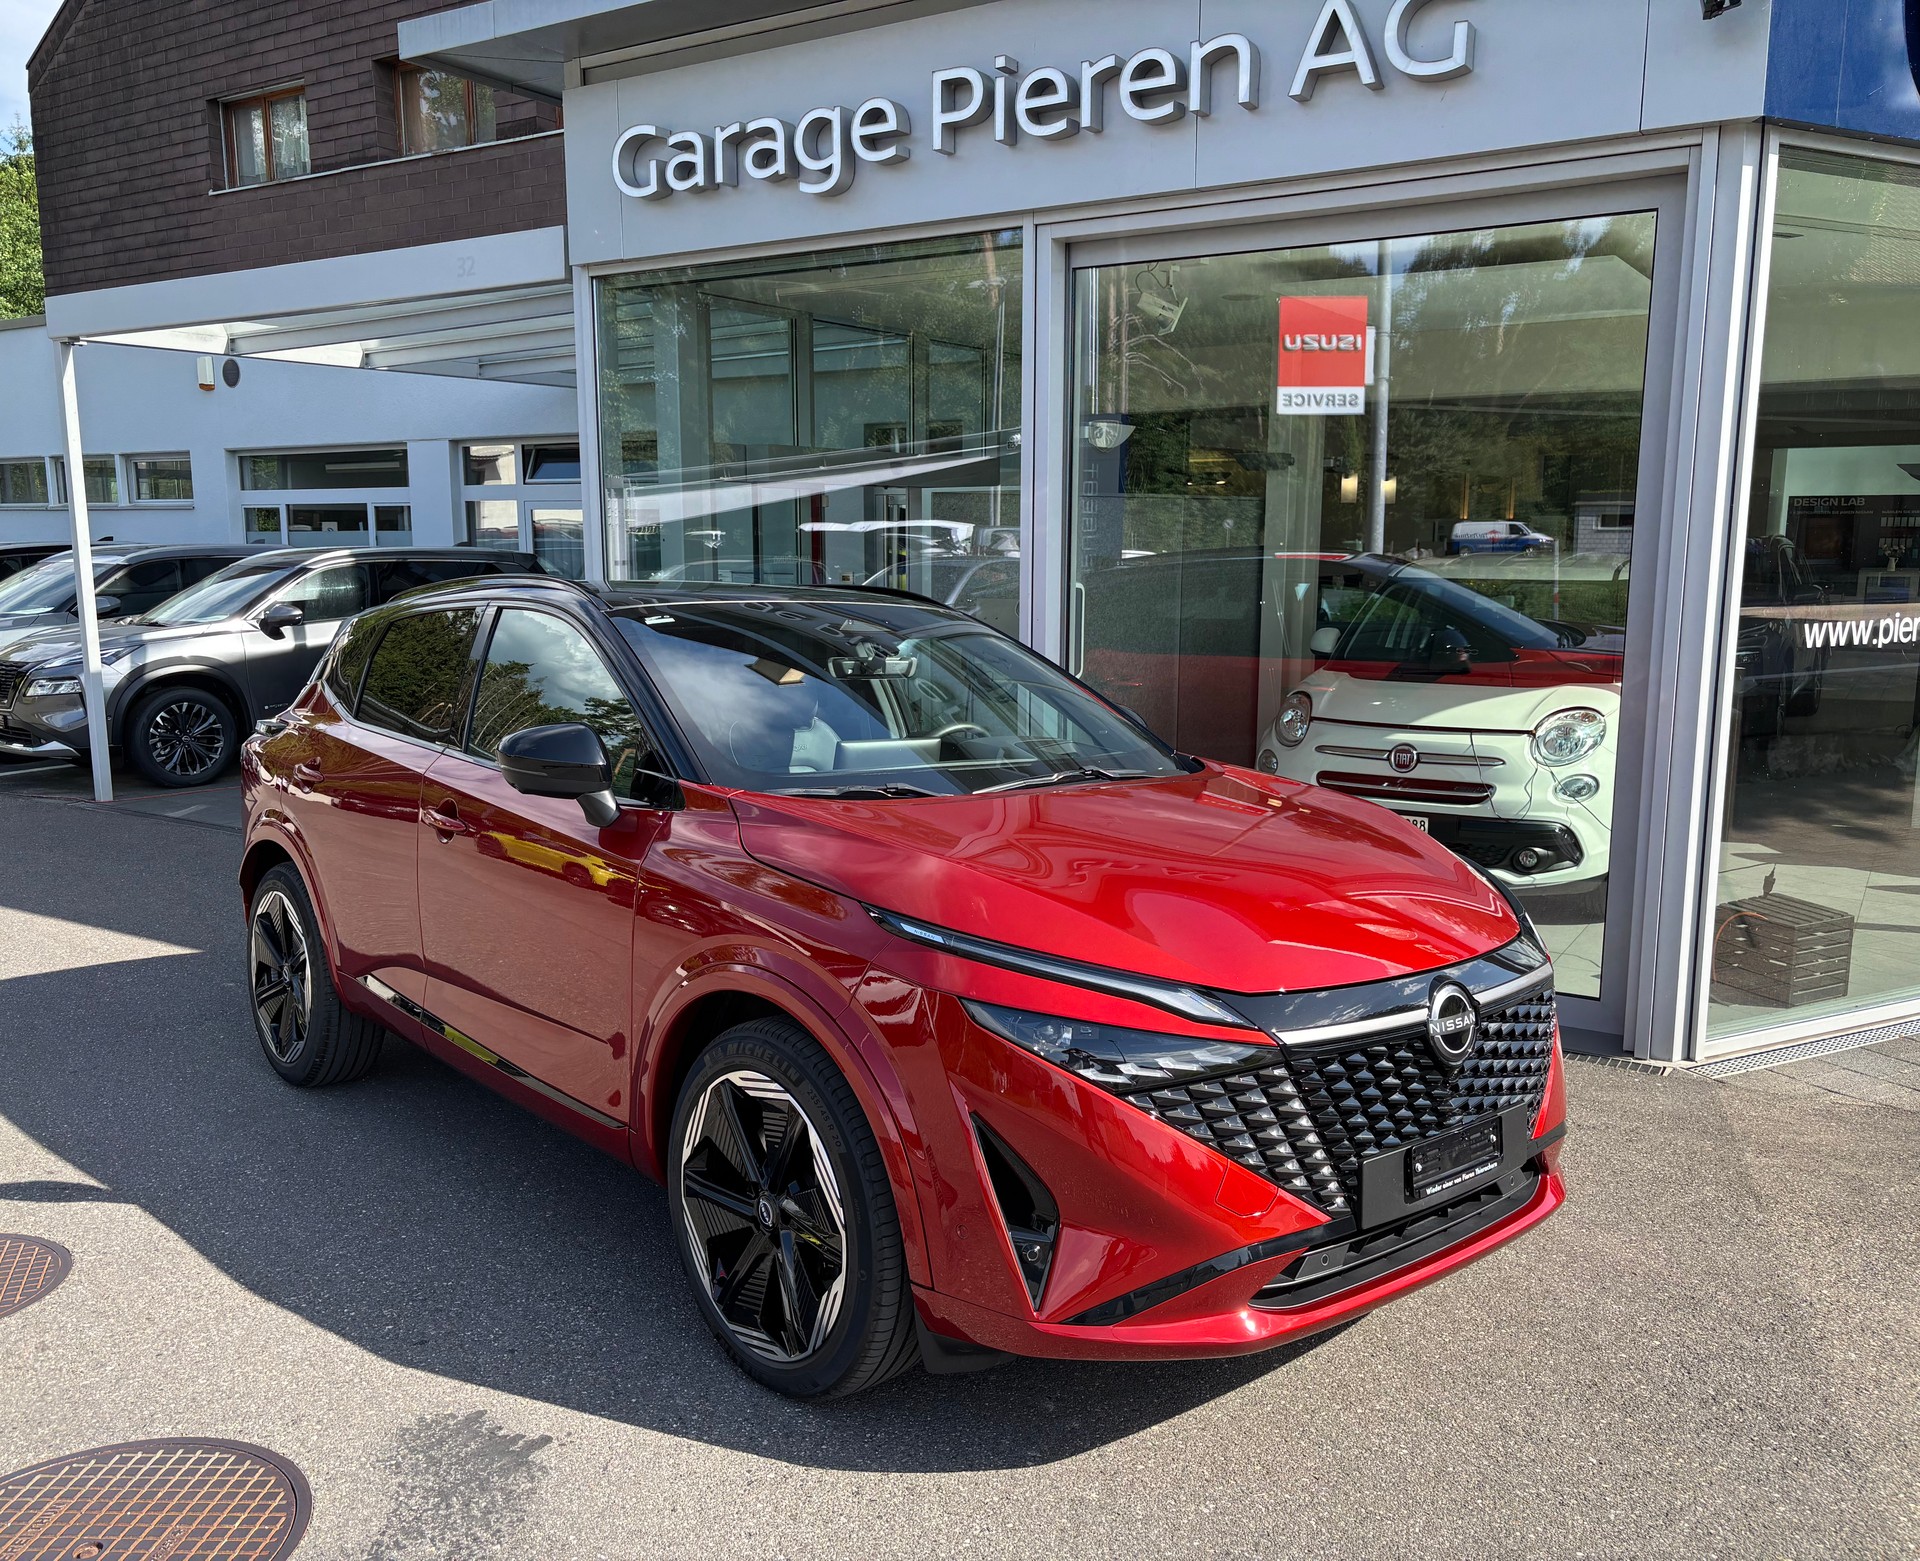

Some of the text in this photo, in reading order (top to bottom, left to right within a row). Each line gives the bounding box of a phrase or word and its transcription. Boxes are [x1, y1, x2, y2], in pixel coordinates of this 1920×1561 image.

[611, 0, 1476, 199] Garage Pieren AG
[456, 255, 477, 278] 32
[1793, 497, 1866, 507] DESIGN LAB
[1395, 752, 1412, 765] FIAT
[1429, 1011, 1476, 1034] NISSAN
[727, 1041, 801, 1084] MICHELIN
